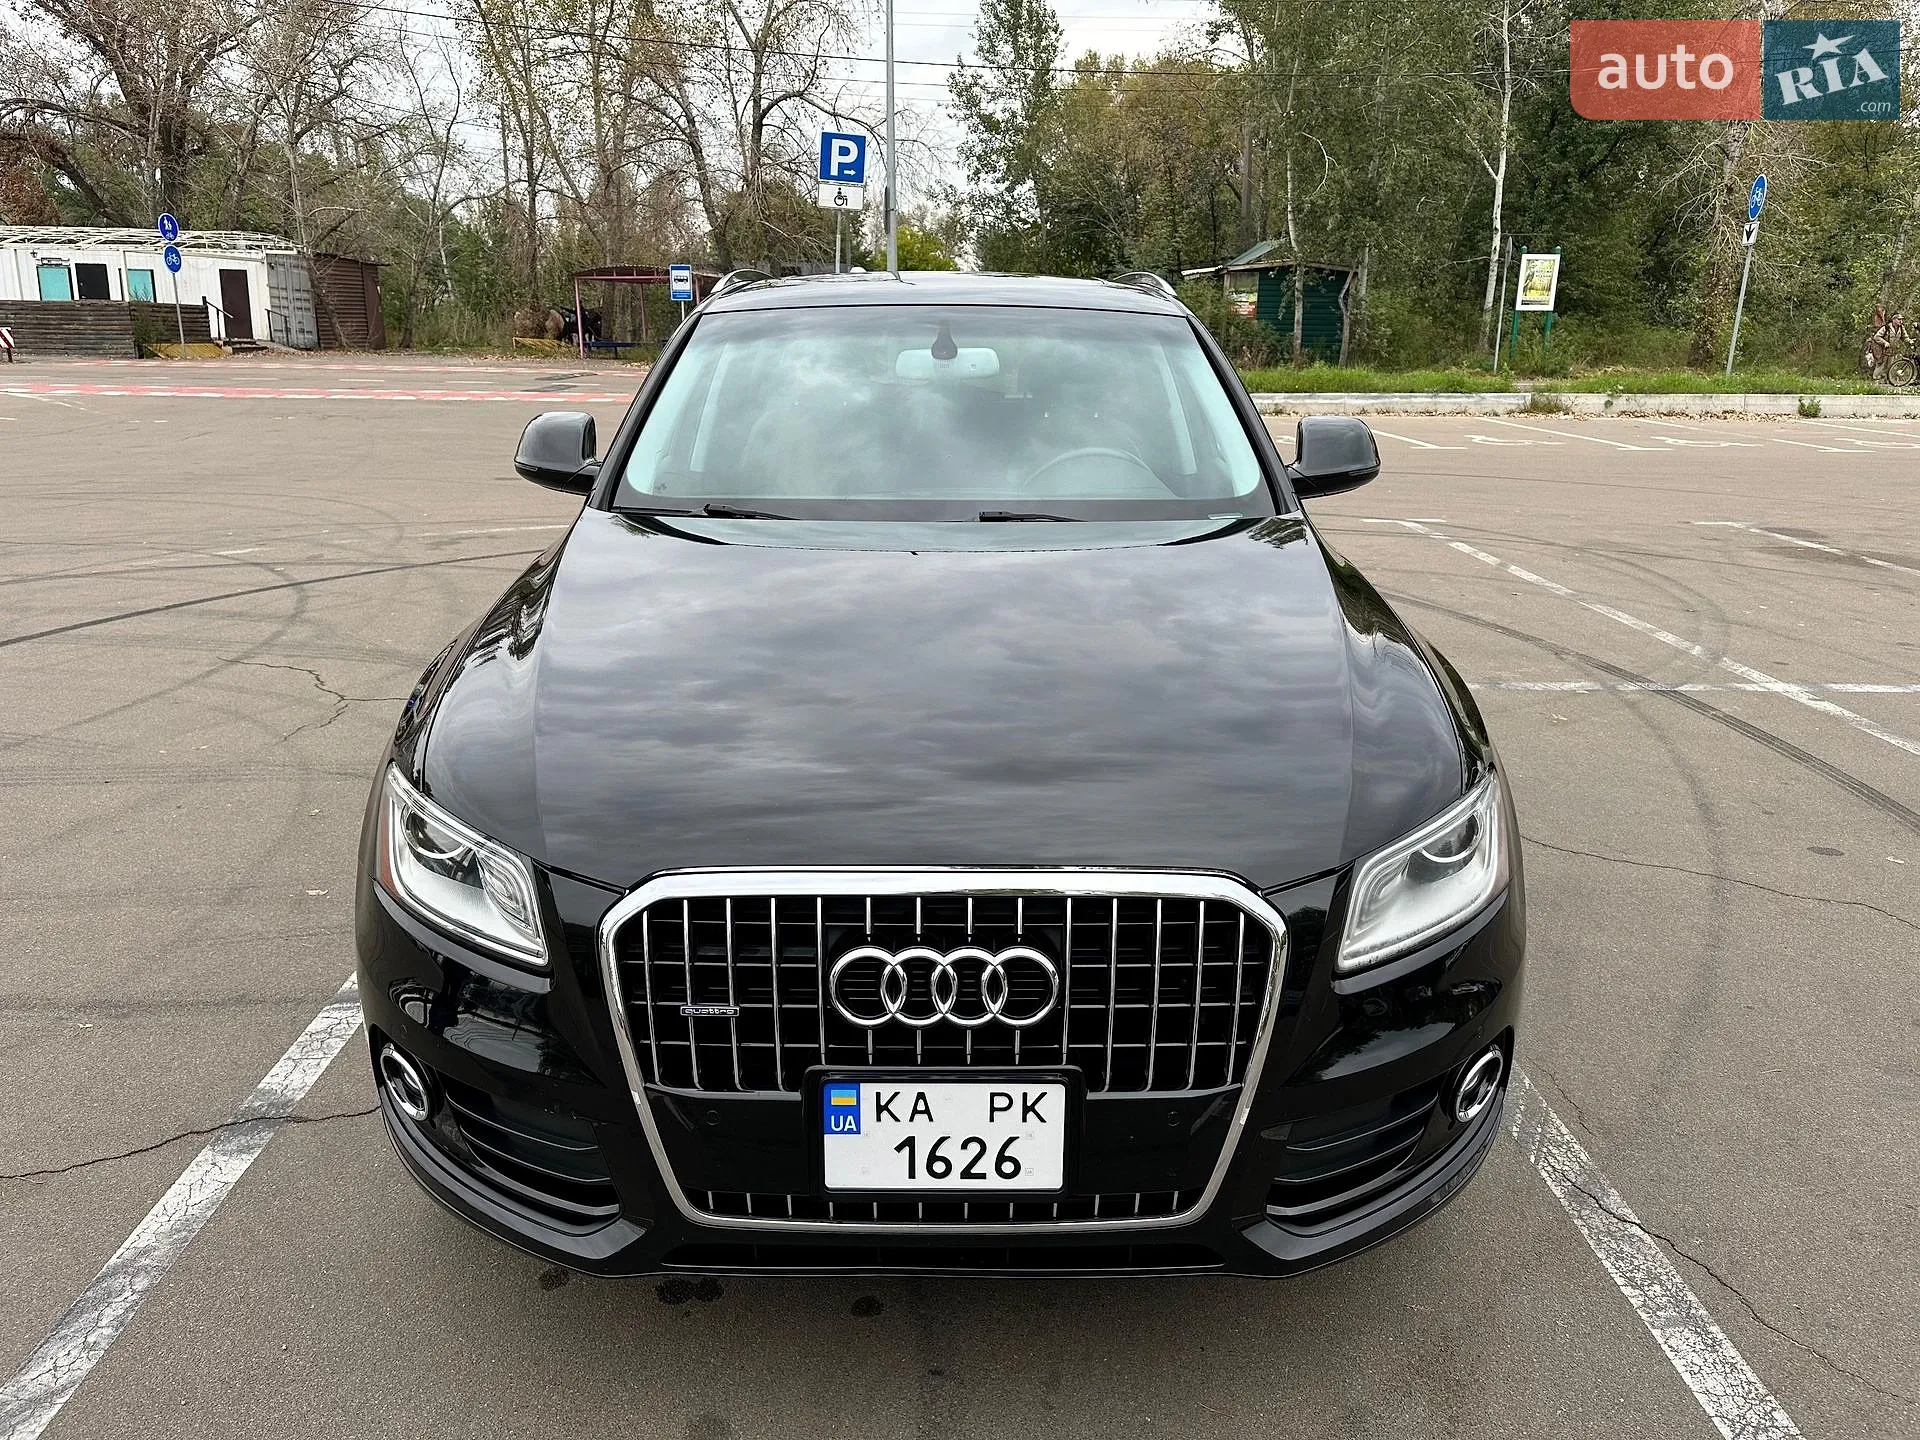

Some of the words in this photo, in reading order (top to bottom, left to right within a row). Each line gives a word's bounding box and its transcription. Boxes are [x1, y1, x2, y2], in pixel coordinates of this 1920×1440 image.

[830, 139, 859, 176] P
[684, 1008, 735, 1016] quattro
[875, 1091, 934, 1123] KA
[988, 1091, 1048, 1123] PK
[830, 1115, 857, 1132] UA
[893, 1135, 1022, 1180] 1626
